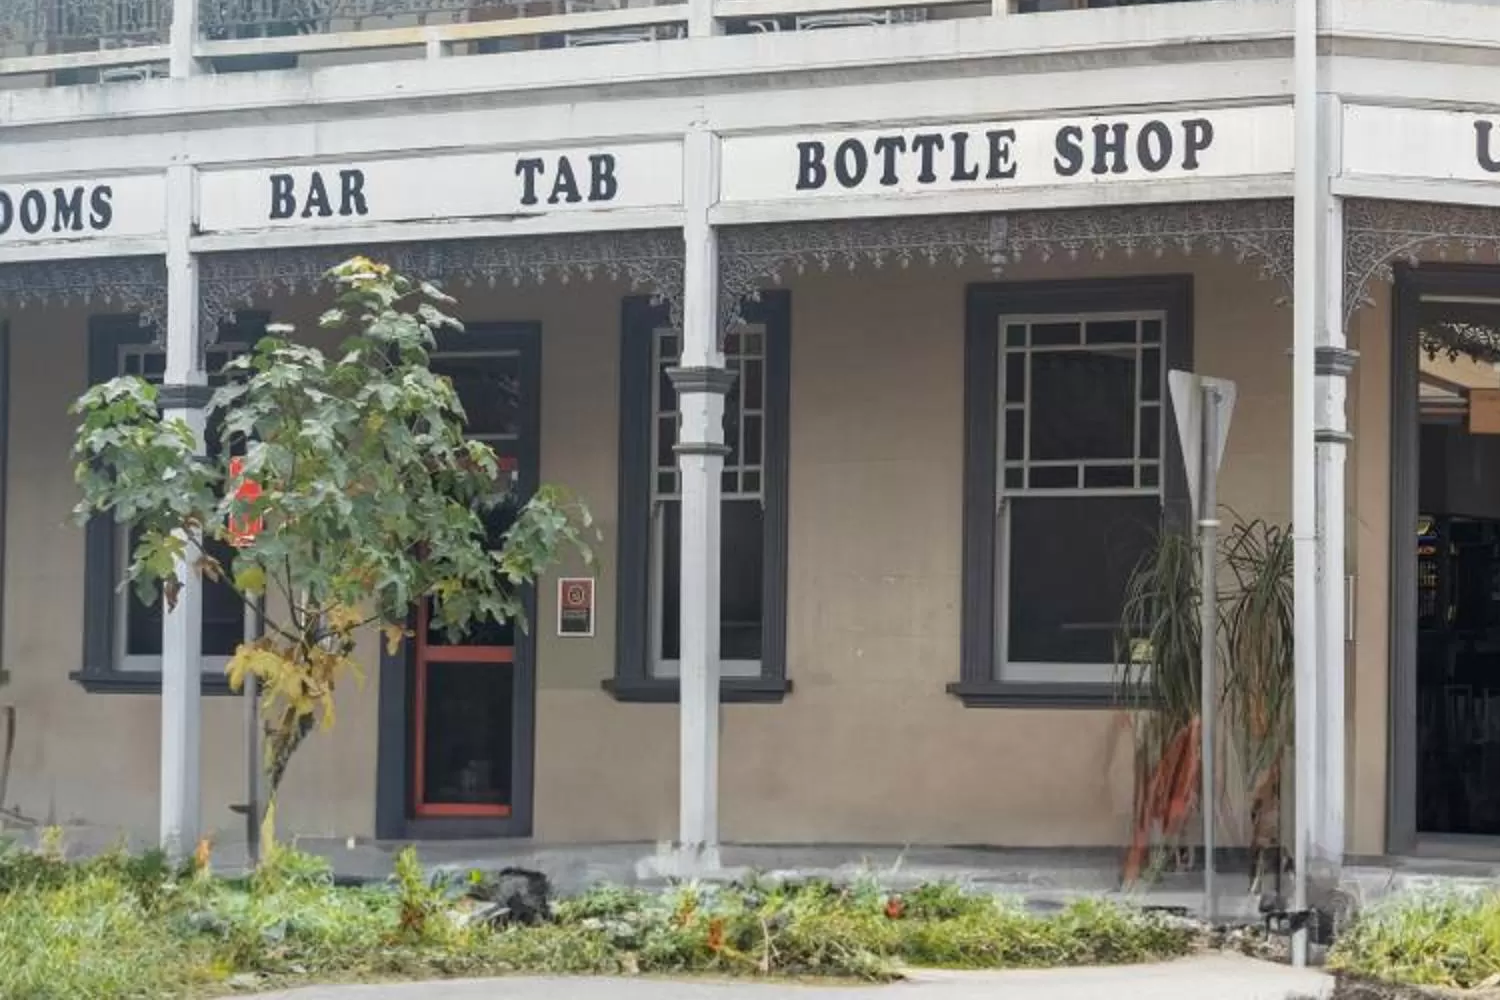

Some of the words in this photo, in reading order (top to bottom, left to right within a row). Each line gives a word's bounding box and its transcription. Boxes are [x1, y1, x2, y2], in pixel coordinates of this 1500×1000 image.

[269, 169, 369, 220] BAR
[514, 153, 618, 206] TAB
[795, 128, 1017, 191] BOTTLE
[1053, 118, 1214, 177] SHOP
